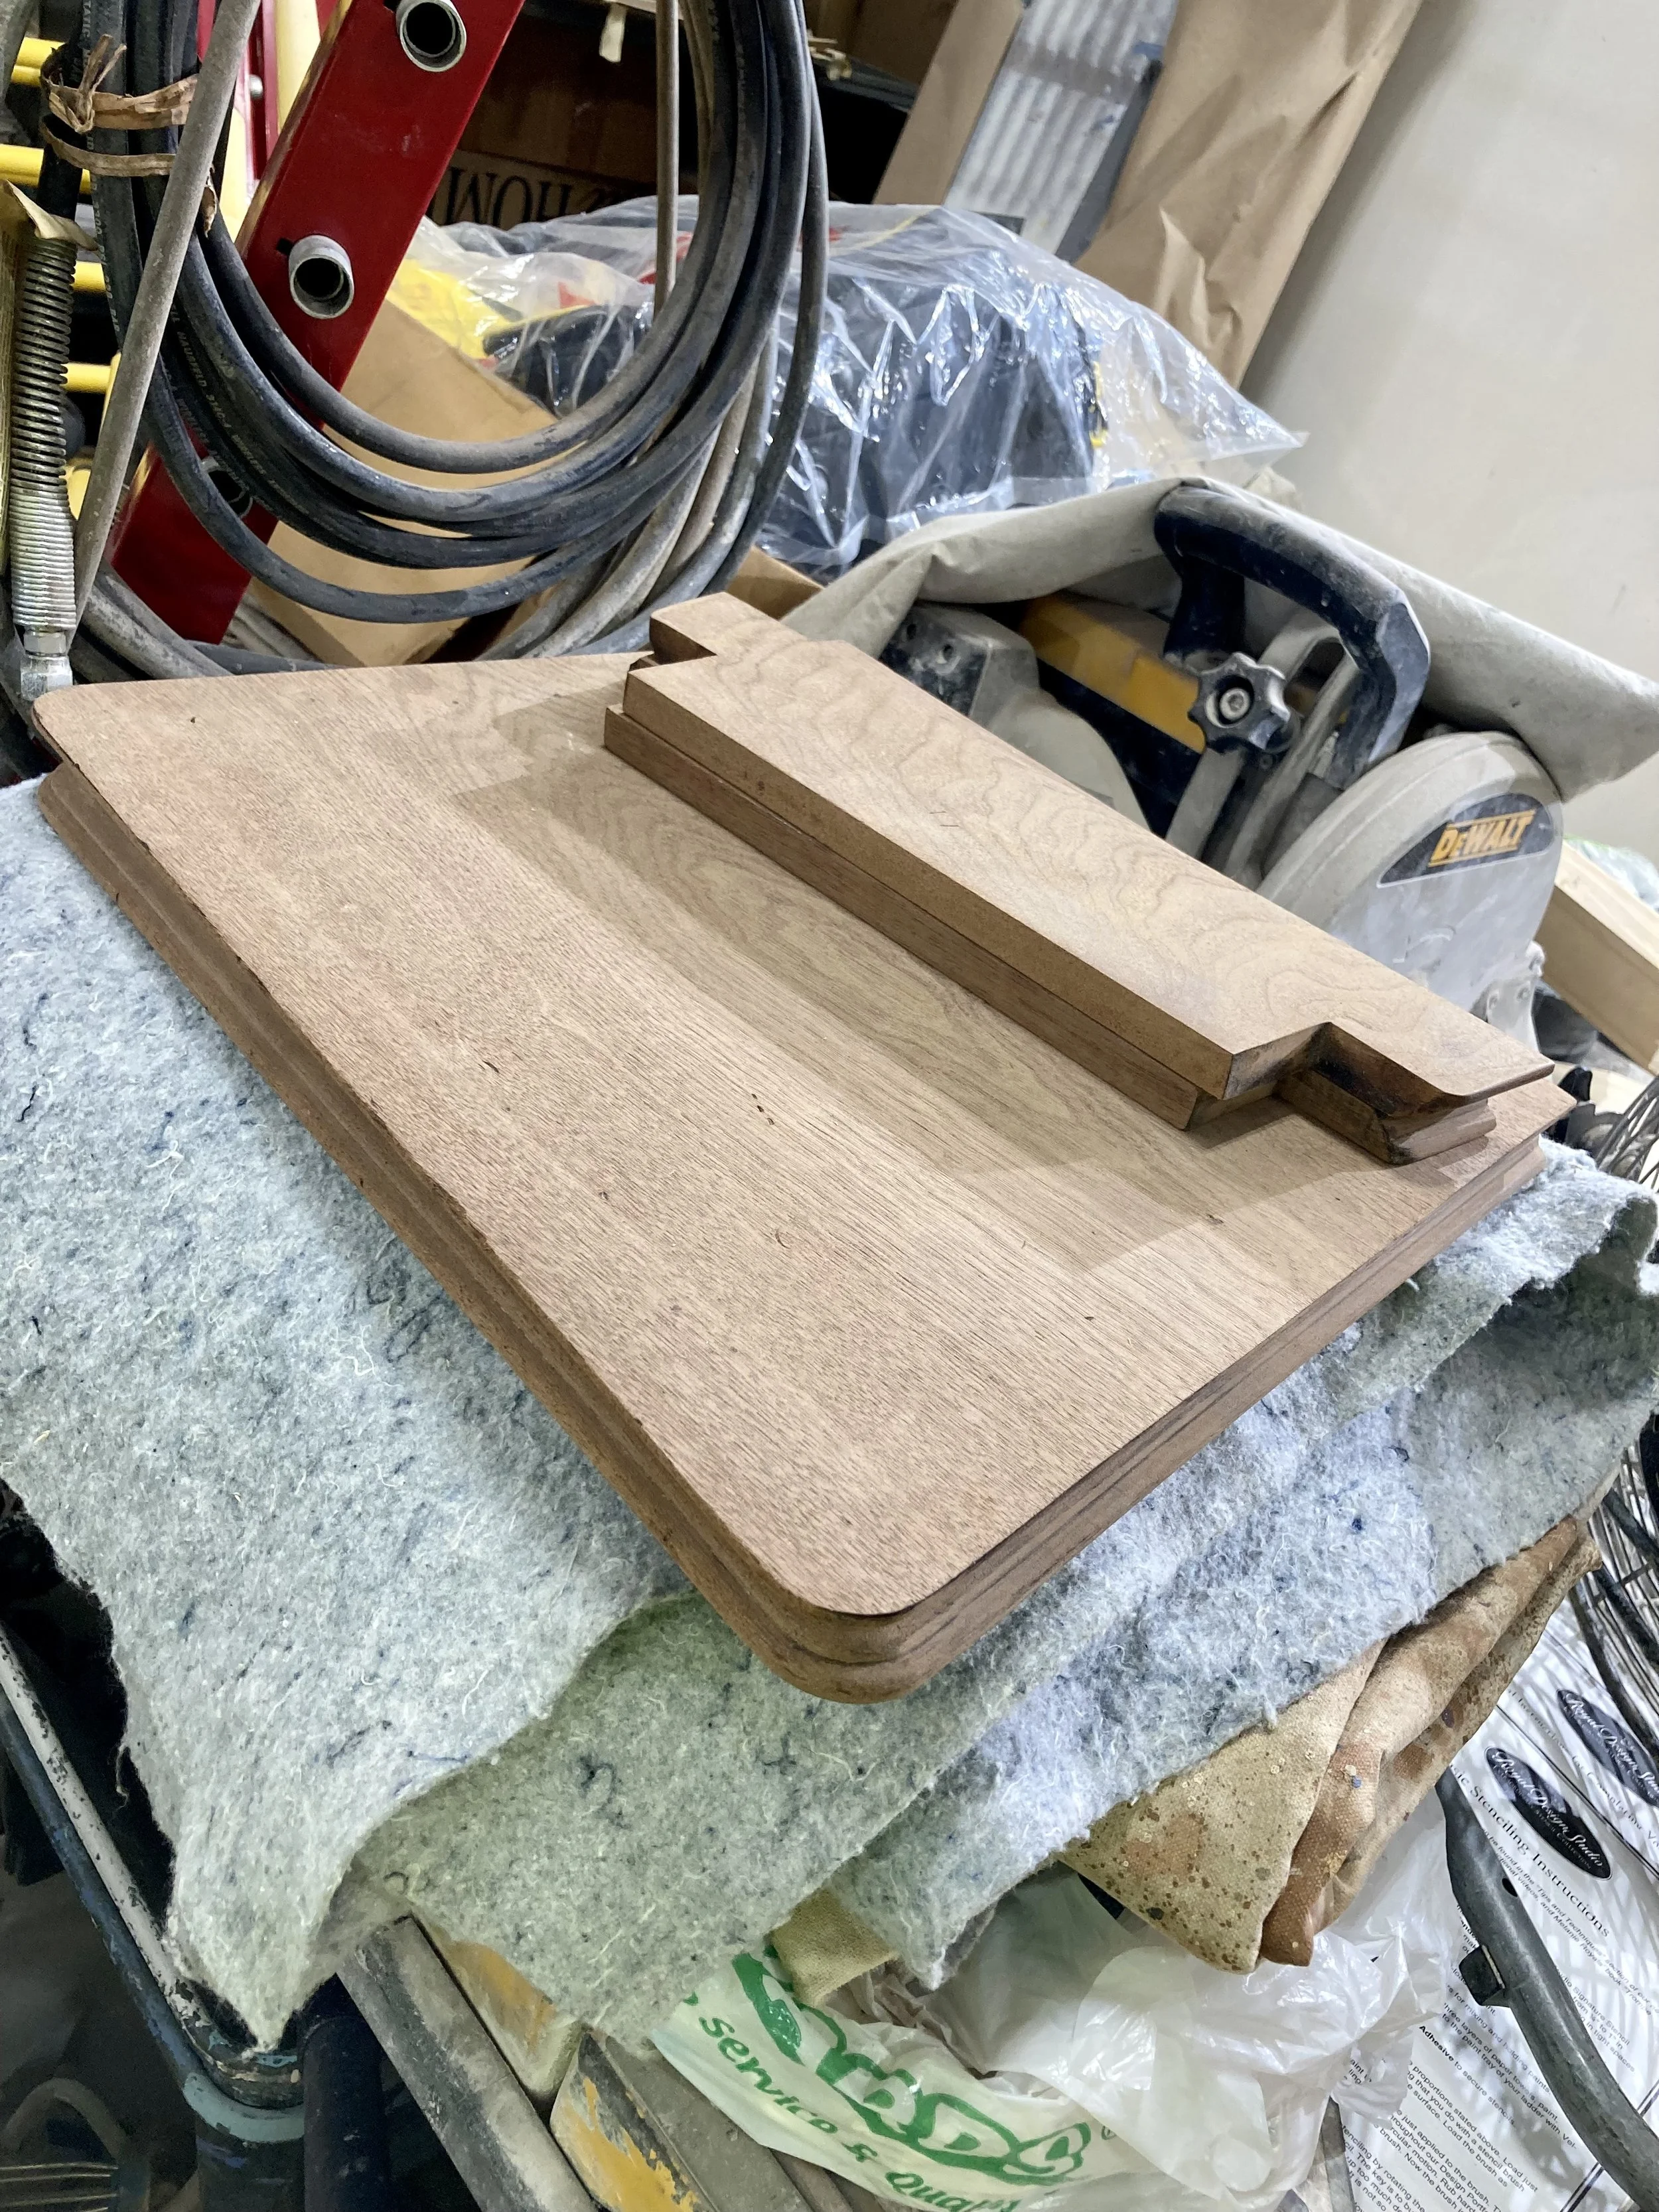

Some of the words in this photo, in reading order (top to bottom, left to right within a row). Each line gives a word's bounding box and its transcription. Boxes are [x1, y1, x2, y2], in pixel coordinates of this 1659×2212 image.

[1561, 1690, 1605, 1735] Royal
[1595, 1724, 1643, 1773] Design
[1490, 1747, 1537, 1795] Royal
[1524, 1785, 1574, 1835] Design
[1567, 1829, 1607, 1869] Studio
[1464, 1785, 1536, 1856] Stenciling
[1529, 1852, 1615, 1938] Instructions
[1522, 1872, 1536, 1885] the
[1550, 1902, 1565, 1917] and
[1628, 1982, 1638, 1992] of
[1540, 1900, 1555, 1915] and
[1603, 1967, 1623, 1986] book
[1453, 1992, 1465, 2004] for
[1463, 2003, 1489, 2029] mixing
[1487, 2026, 1504, 2043] and
[1500, 2041, 1530, 2071] holding
[1459, 2022, 1484, 2047] layers
[1482, 2044, 1492, 2054] of
[1489, 2053, 1513, 2077] paper
[1571, 1986, 1607, 2022] Signature
[1605, 2020, 1630, 2045] Stencil
[1585, 2022, 1594, 2030] in
[1592, 2029, 1611, 2047] tight
[1598, 2023, 1609, 2033] to
[1615, 2040, 1624, 2050] in
[1417, 2024, 1456, 2062] Adhesive
[1453, 2060, 1464, 2071] to
[1461, 2069, 1488, 2097] secure
[1441, 2013, 1451, 2023] to
[1449, 2021, 1463, 2035] the
[1461, 2033, 1482, 2056] paint
[1479, 2053, 1497, 2071] tray
[1495, 2068, 1506, 2079] of
[1503, 2077, 1522, 2096] your
[1520, 2093, 1545, 2119] ladder
[1544, 2116, 1562, 2135] with
[1560, 2133, 1578, 2151] Vel-
[1401, 2114, 1418, 2132] just
[1415, 2129, 1446, 2160] applied
[1443, 2158, 1455, 2168] to
[1452, 2166, 1467, 2181] the
[1465, 2179, 1492, 2207] brush.
[1411, 2065, 1455, 2109] proportions
[1452, 2106, 1479, 2133] stated
[1475, 2130, 1504, 2158] above.
[1502, 2156, 1524, 2178] Load
[1520, 2175, 1539, 2194] just
[1413, 2079, 1431, 2096] that
[1427, 2095, 1445, 2112] you
[1443, 2109, 1457, 2122] do
[1454, 2120, 1473, 2138] with
[1476, 2142, 1504, 2170] stencil
[1501, 2168, 1526, 2193] brush
[1441, 2119, 1464, 2142] Load
[1461, 2139, 1477, 2155] the
[1474, 2153, 1499, 2177] brush
[1496, 2175, 1509, 2188] as
[1353, 2178, 1363, 2187] is
[1362, 2186, 1377, 2201] not
[1354, 2152, 1373, 2170] The
[1370, 2169, 1388, 2187] key
[1386, 2184, 1396, 2194] is
[1394, 2193, 1404, 2203] to
[1355, 2167, 1371, 2182] too
[1369, 2181, 1394, 2205] much
[1370, 2157, 1384, 2171] by
[1381, 2168, 1413, 2201] rotating
[1378, 2127, 1406, 2154] brush.
[1403, 2152, 1423, 2173] Now
[1420, 2170, 1436, 2186] the
[1433, 2184, 1459, 2209] brush
[1410, 2148, 1441, 2179] motion.
[1439, 2177, 1457, 2196] Rub
[1424, 2151, 1439, 2166] our
[1437, 2164, 1467, 2194] Design
